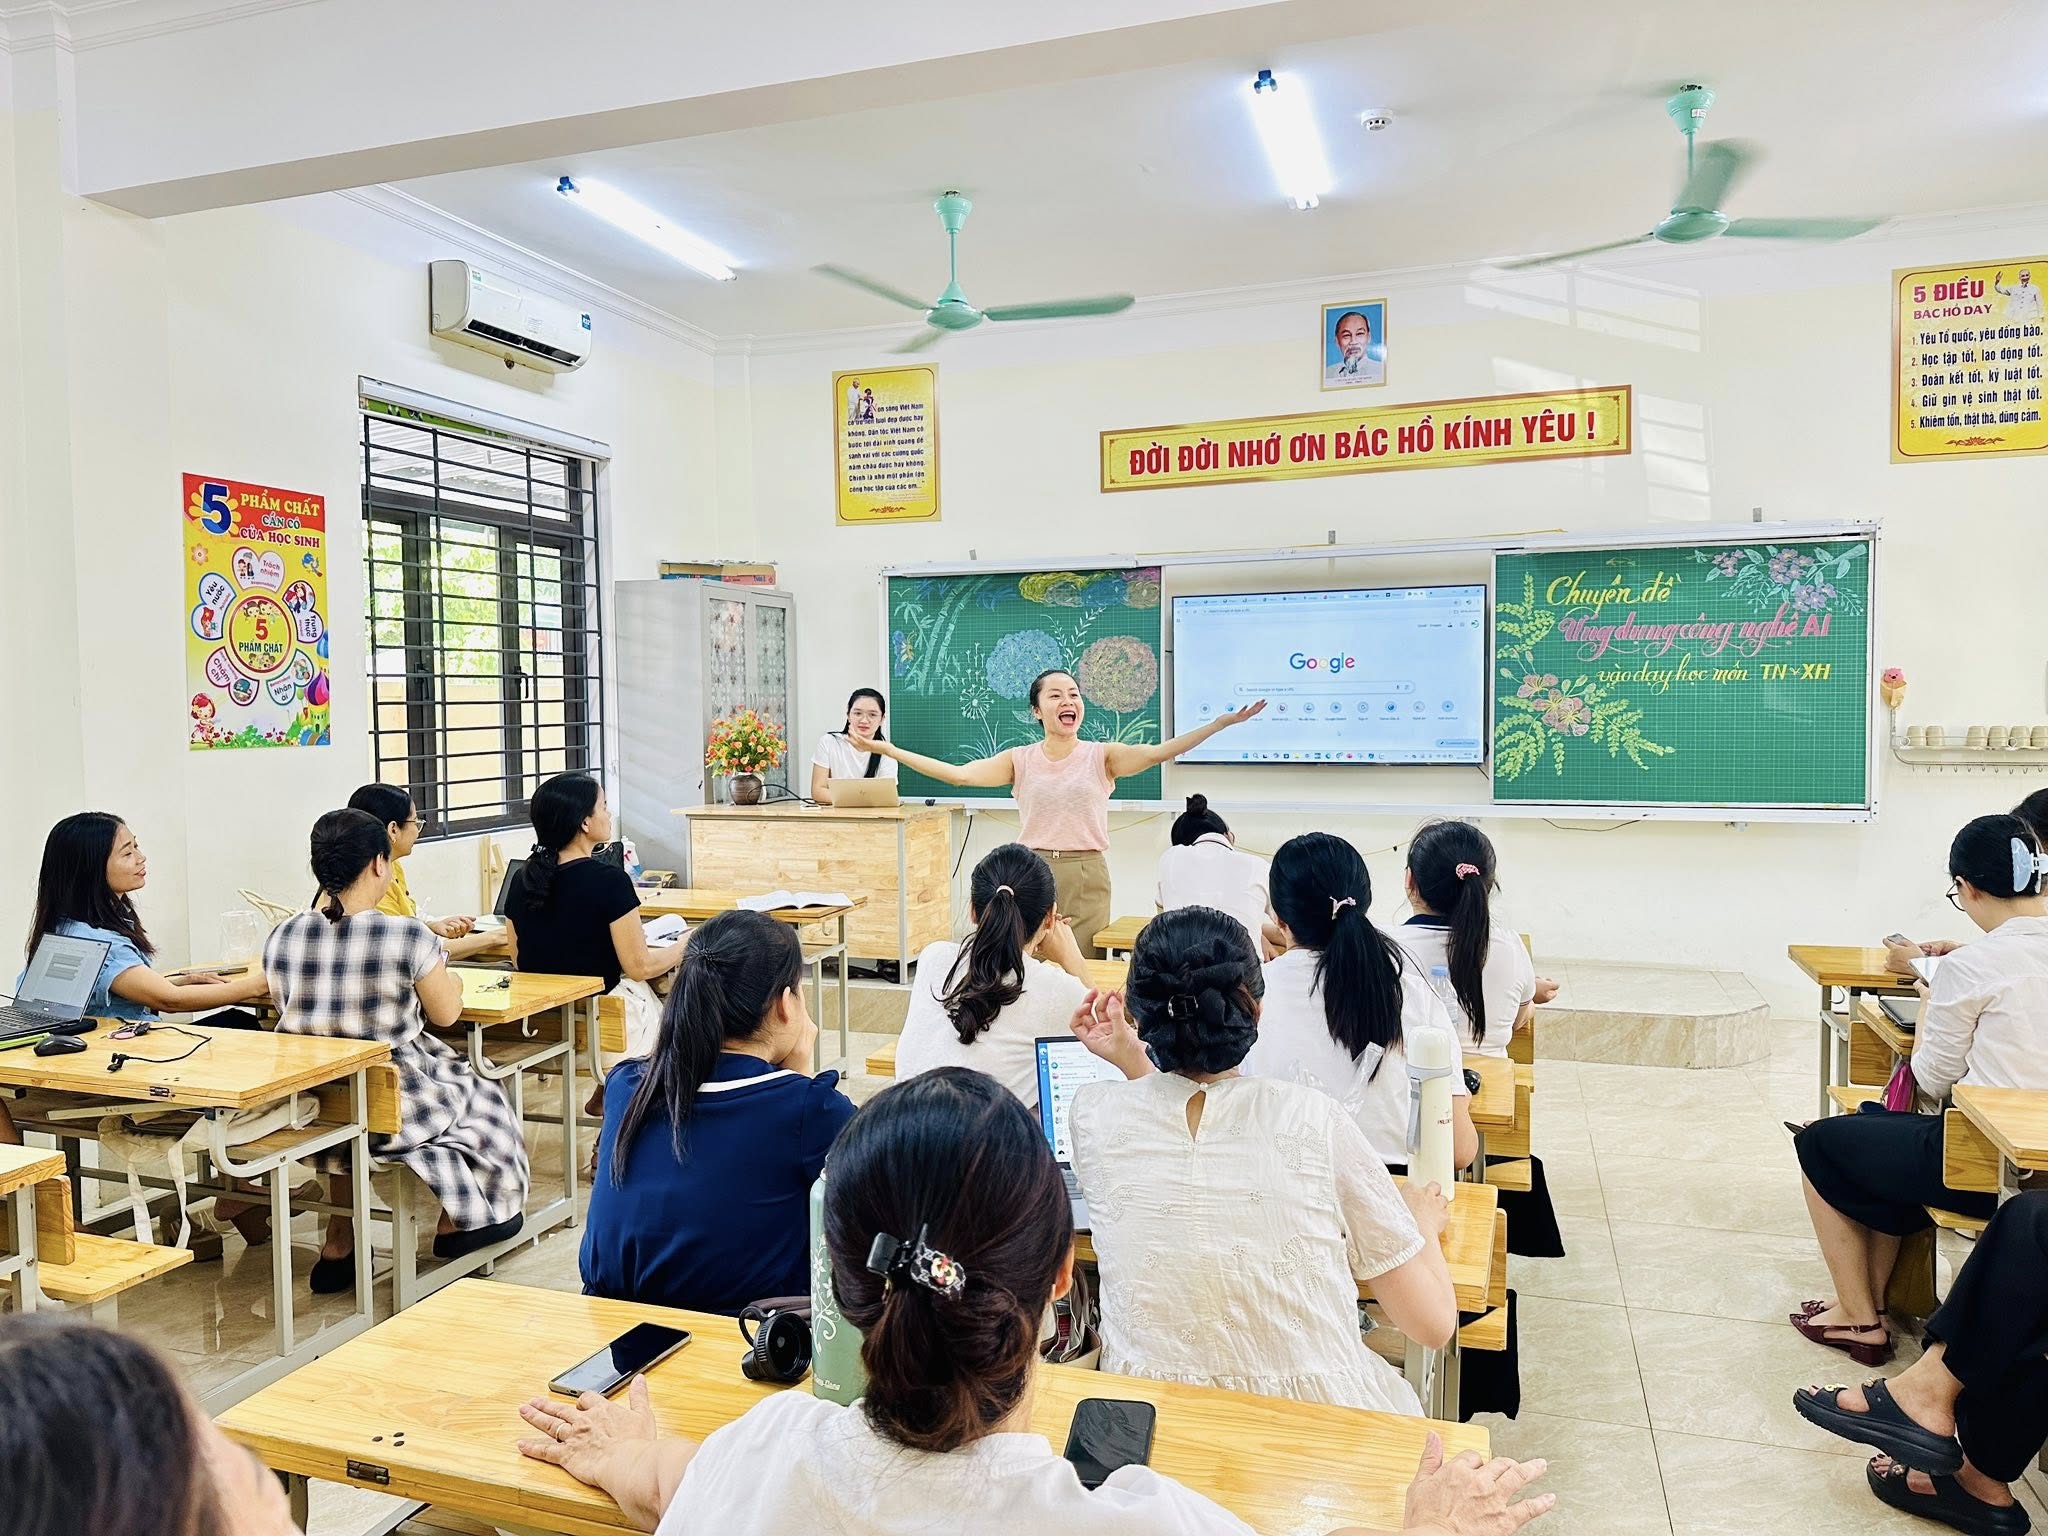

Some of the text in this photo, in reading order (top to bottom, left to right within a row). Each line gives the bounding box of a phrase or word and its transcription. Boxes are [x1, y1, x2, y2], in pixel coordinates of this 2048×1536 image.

[1914, 275, 1985, 303] 5 ĐIỀU
[1912, 336, 1918, 345] 1.
[1920, 332, 1936, 345] Yêu
[1952, 327, 1976, 344] quốc,
[1979, 328, 1995, 342] yêu
[2023, 323, 2043, 336] bào.
[1911, 343, 2043, 368] 2. Học tập tốt, lao động tốt.
[1911, 378, 1917, 387] 3.
[1922, 373, 1944, 386] Đoàn
[1949, 369, 1963, 384] kết
[1968, 369, 1983, 383] tốt,
[2004, 367, 2022, 382] luật
[2027, 364, 2043, 378] tốt.
[1922, 393, 1937, 407] Giữ
[1962, 391, 1972, 407] vệ
[1978, 390, 1998, 403] sinh
[2003, 389, 2021, 404] thật
[2027, 385, 2042, 400] tốt.
[1911, 419, 1917, 429] 5.
[1920, 415, 1944, 428] Khiêm
[1947, 412, 1962, 427] tốn,
[1964, 412, 1979, 427] thật
[2000, 410, 2018, 424] dũng
[1130, 442, 1170, 476] ĐỜI
[1178, 437, 1219, 472] ĐỜI
[1228, 432, 1282, 468] NHỚ
[1289, 432, 1326, 463] ƠN
[1335, 424, 1388, 459] BÁC
[1397, 414, 1434, 454] HỒ
[1444, 415, 1512, 450] KÍNH
[1521, 409, 1575, 444] YÊU
[201, 482, 232, 534] 5
[240, 489, 320, 516] PHẨM CHẤT
[240, 525, 320, 548] CỦA HỌC SINH
[1546, 570, 1682, 616] Chuyên đề
[255, 619, 268, 640] 5
[310, 615, 318, 638] Trung
[1558, 601, 1832, 662] Ứng dụng công nghệ AI
[1289, 652, 1355, 673] Google
[1597, 663, 1631, 683] vào
[1633, 660, 1673, 695] dạy
[1672, 653, 1707, 686] học
[1712, 660, 1752, 684] môn
